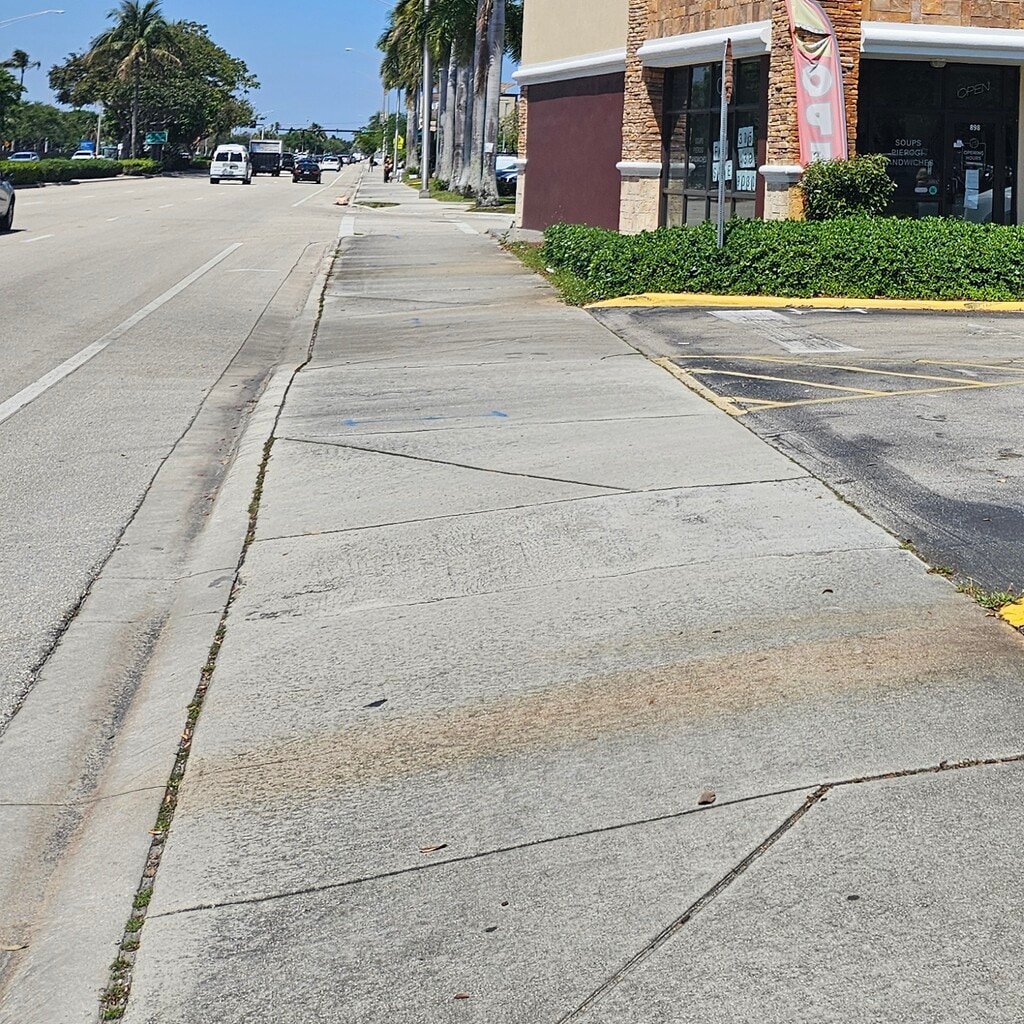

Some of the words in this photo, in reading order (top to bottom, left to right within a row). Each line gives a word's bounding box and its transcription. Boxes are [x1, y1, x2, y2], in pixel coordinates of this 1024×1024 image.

[957, 81, 991, 98] OPEN
[895, 139, 922, 147] SOUPS
[887, 159, 934, 167] ANDWICHES
